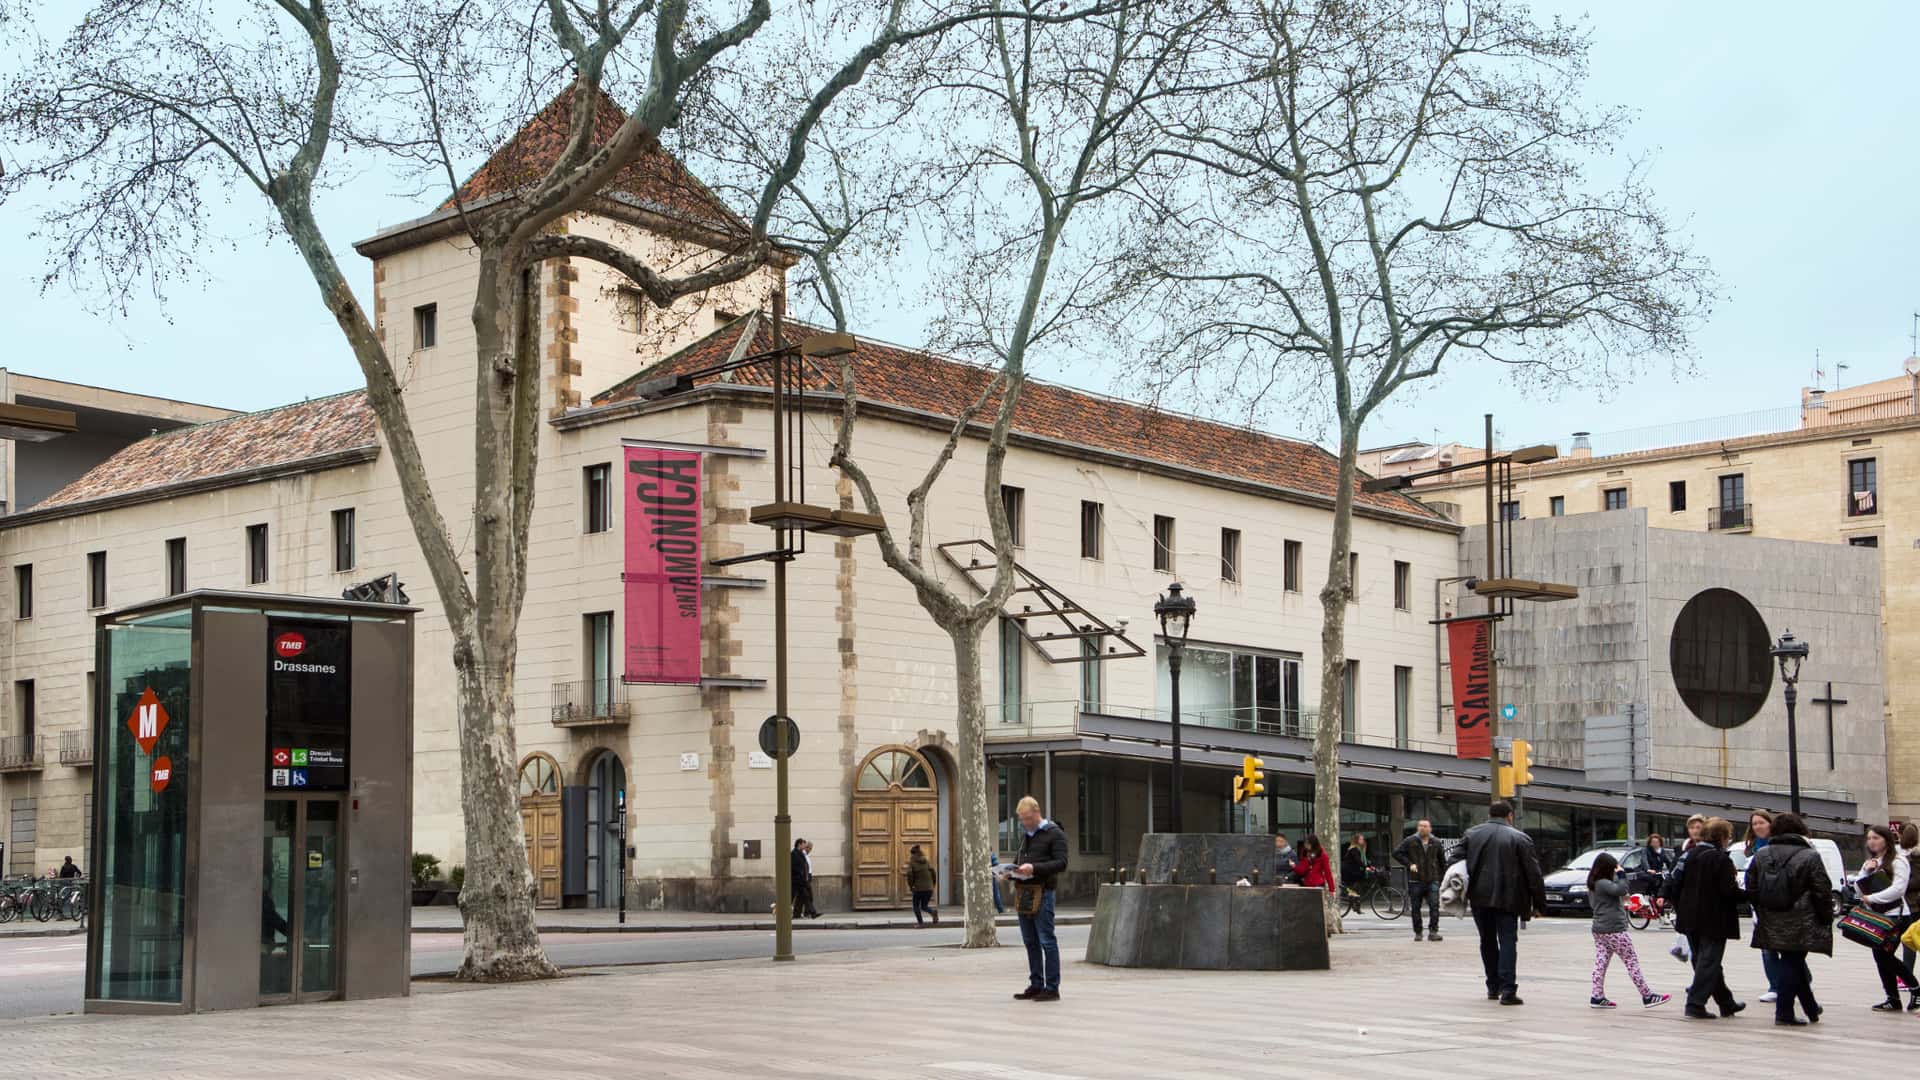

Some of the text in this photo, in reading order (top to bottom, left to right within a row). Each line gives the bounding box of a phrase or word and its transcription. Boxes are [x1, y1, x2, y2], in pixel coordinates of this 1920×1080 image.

[280, 641, 303, 650] TMB
[274, 660, 336, 674] Drassanes
[139, 703, 157, 738] M
[291, 751, 307, 763] L3
[154, 769, 170, 781] TMB
